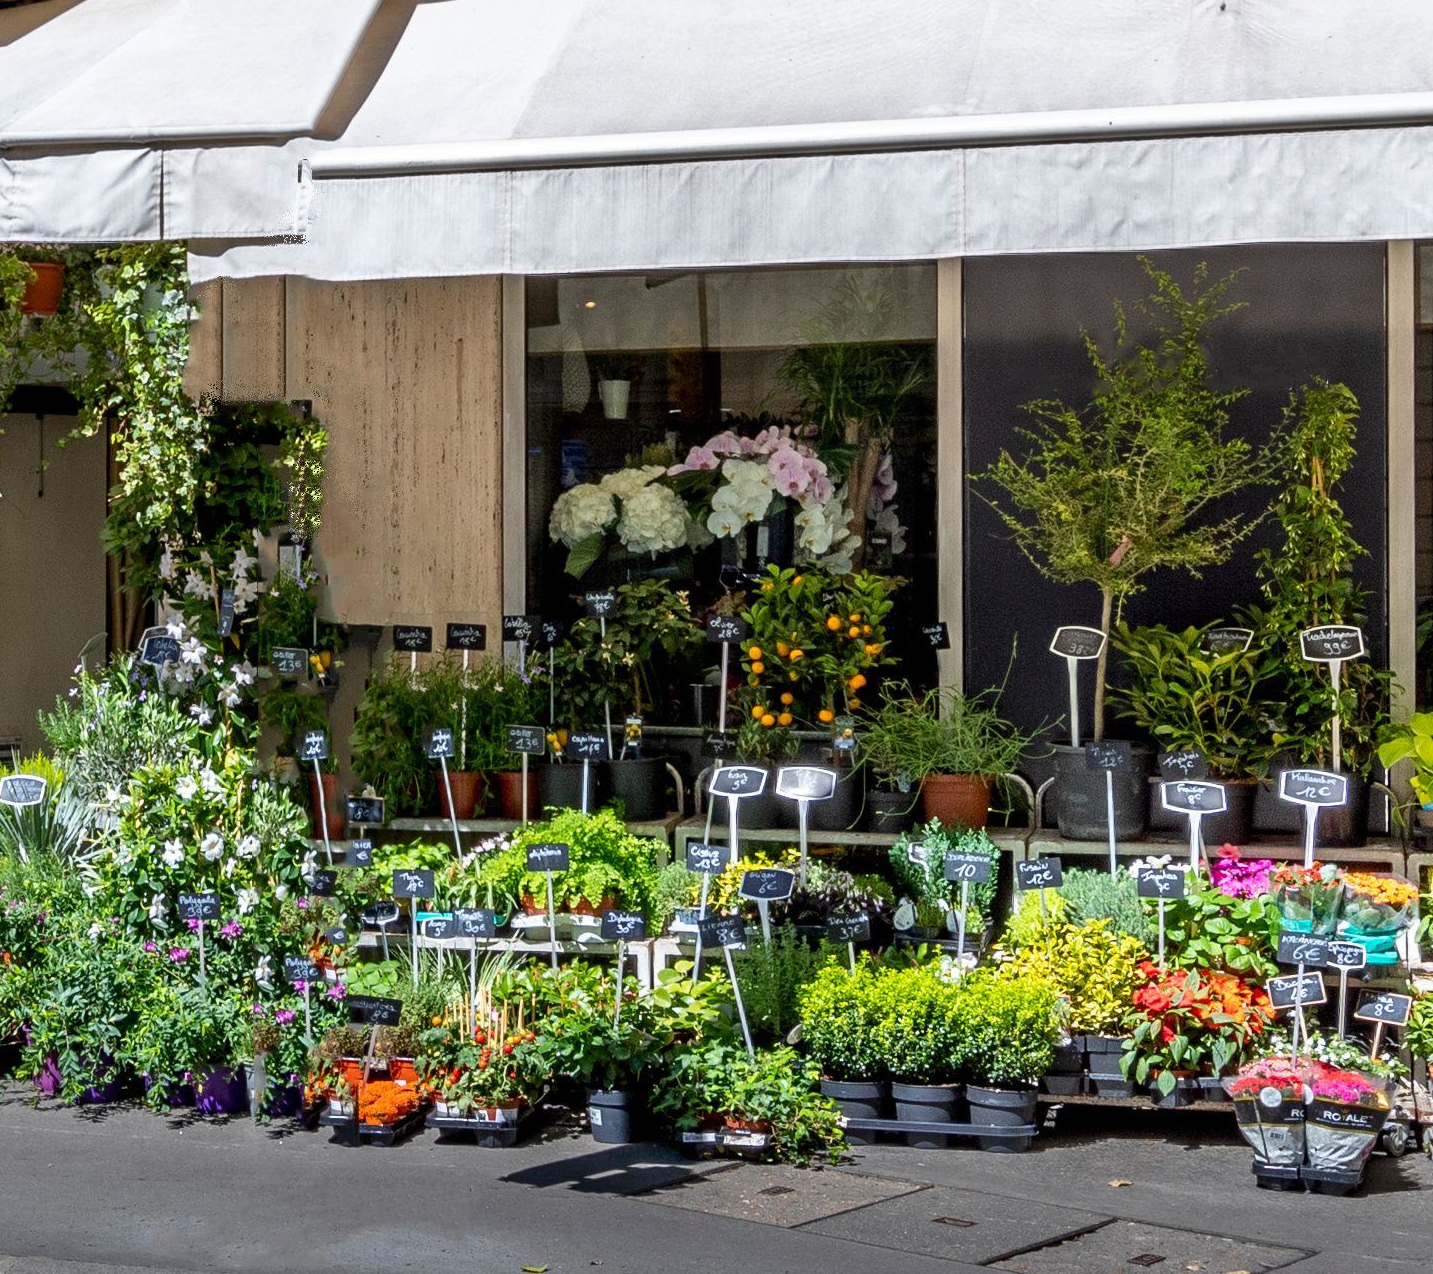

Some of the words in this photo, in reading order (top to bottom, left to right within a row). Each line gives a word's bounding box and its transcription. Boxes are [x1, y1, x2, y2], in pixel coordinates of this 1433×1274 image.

[1323, 641, 1352, 655] 99€
[1295, 786, 1331, 799] 12€
[954, 864, 975, 878] 10
[1026, 872, 1054, 885] 12€
[758, 881, 780, 894] 6€
[716, 928, 742, 944] 8€
[1292, 944, 1321, 961] 6€
[1336, 953, 1355, 964] 8€
[1374, 1003, 1395, 1017] 8€
